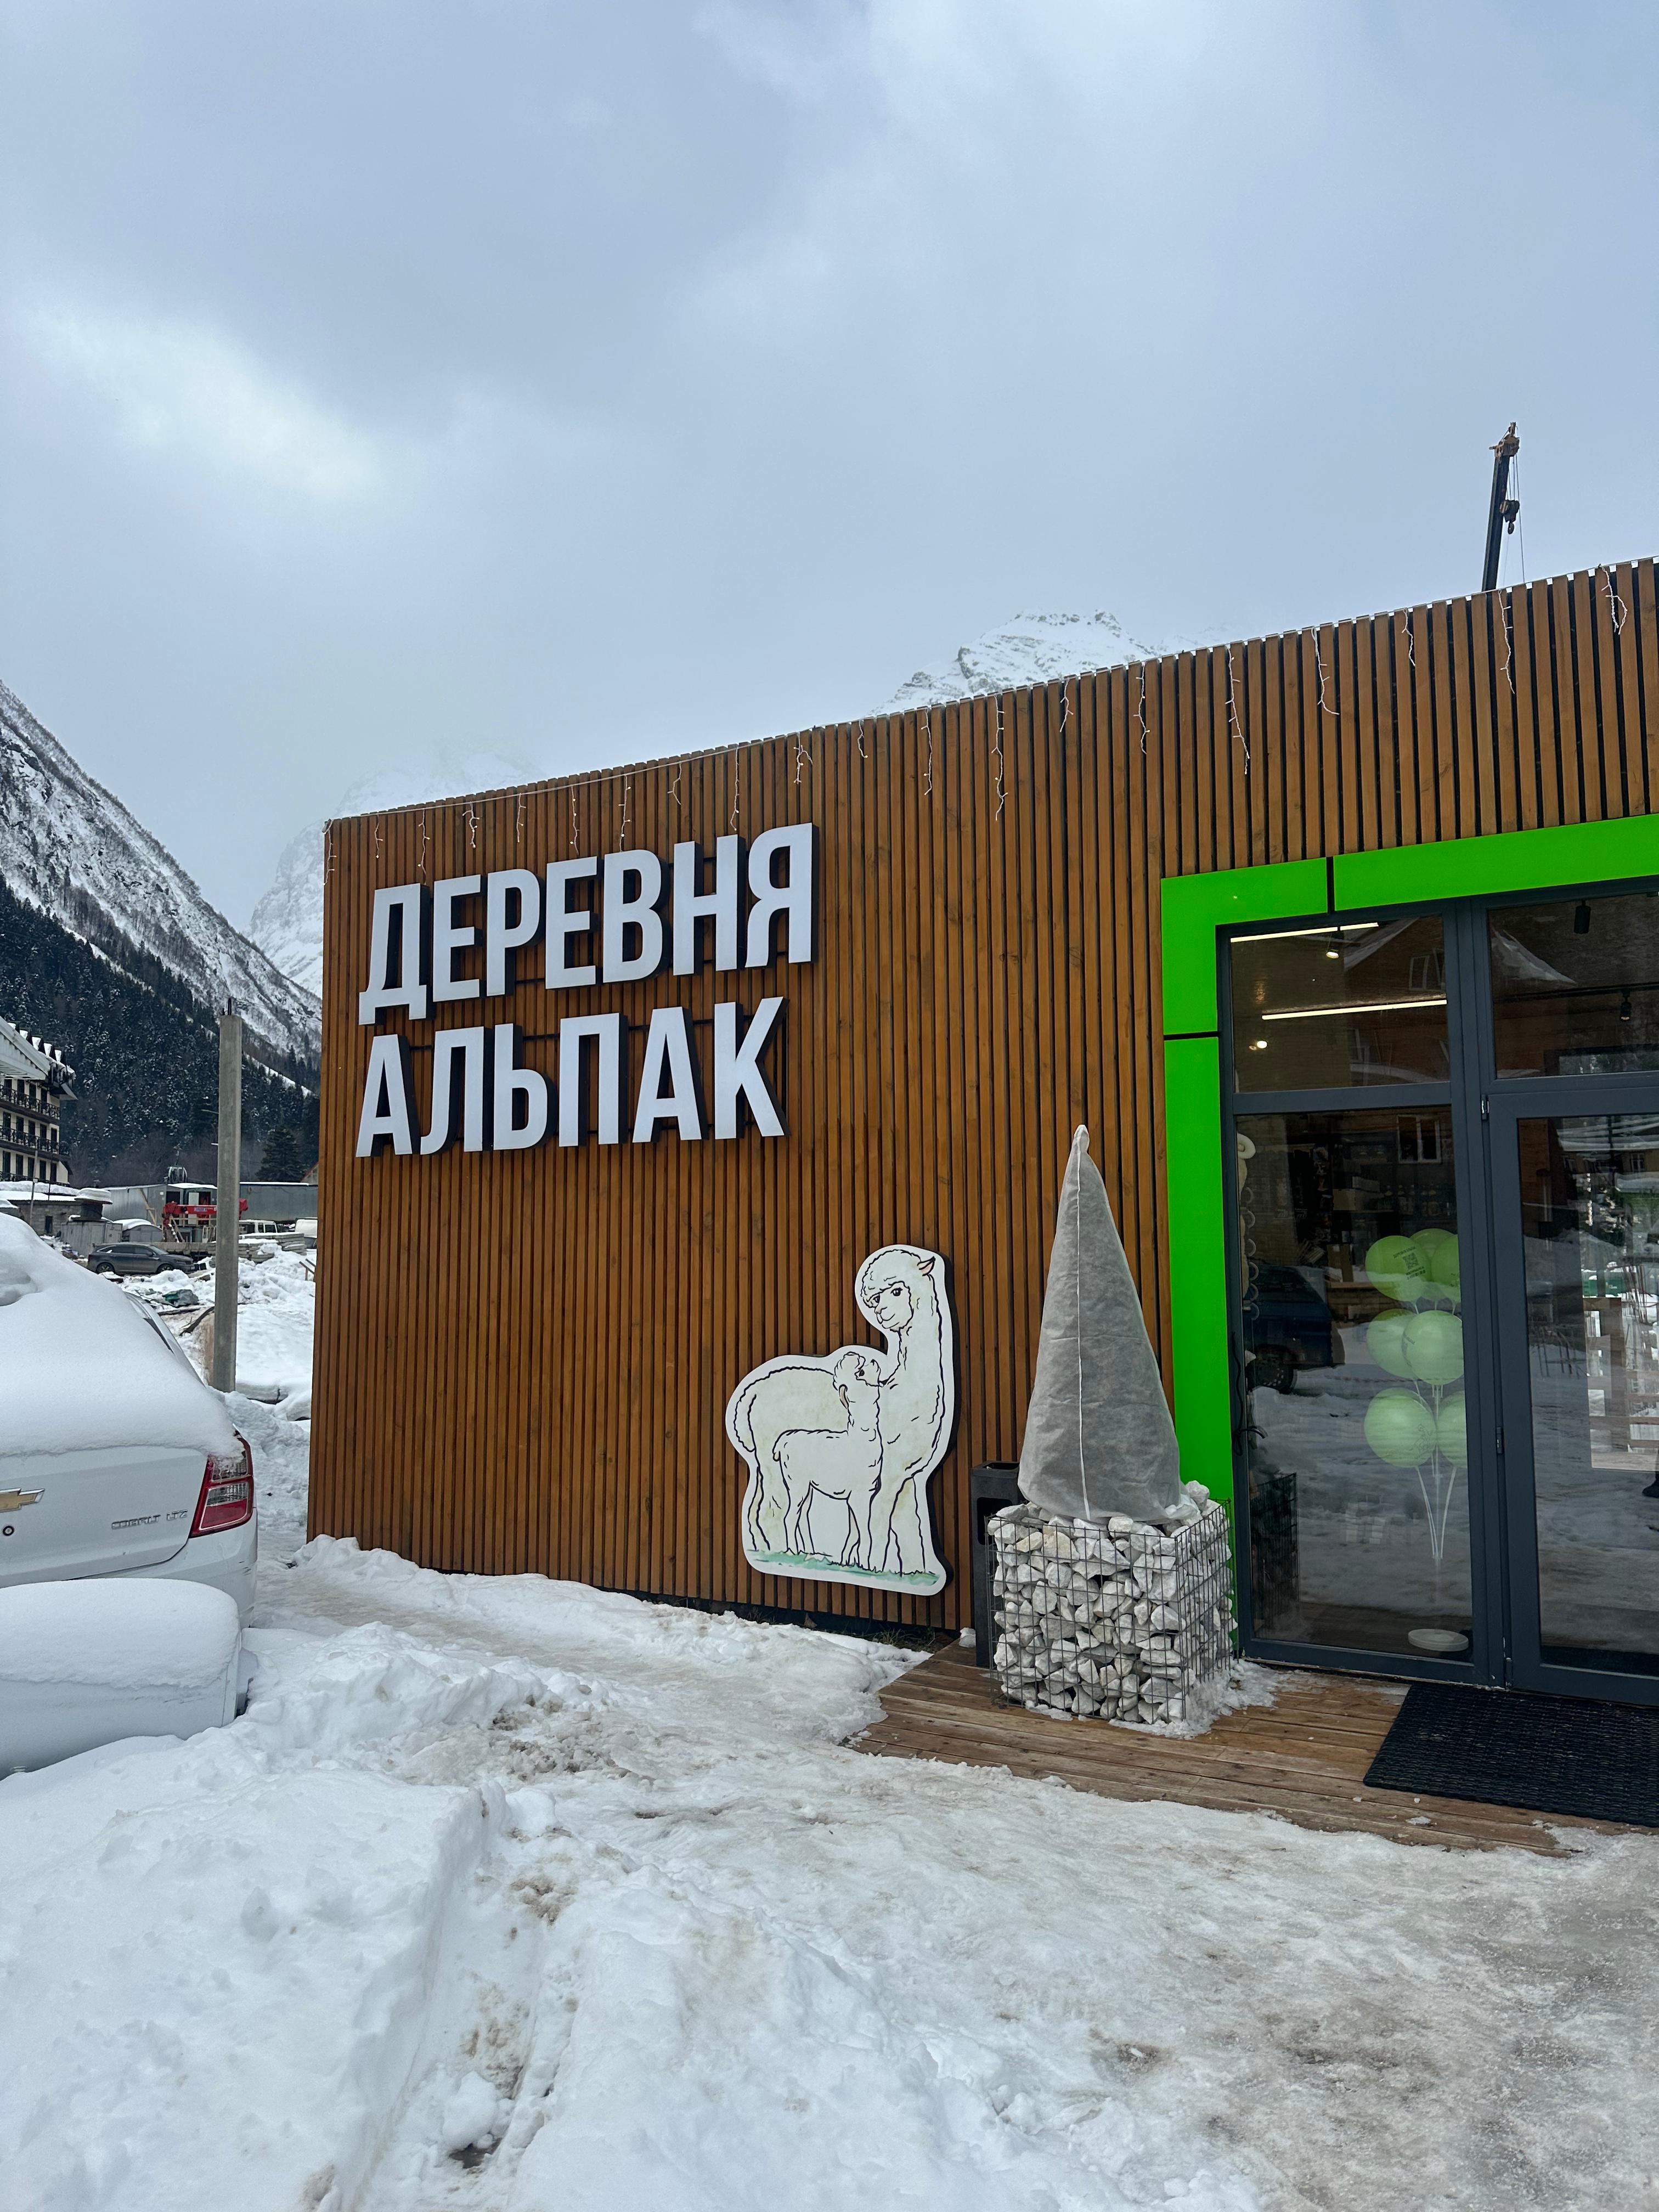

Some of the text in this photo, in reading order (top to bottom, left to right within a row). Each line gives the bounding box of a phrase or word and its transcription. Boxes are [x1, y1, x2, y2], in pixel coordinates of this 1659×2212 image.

[359, 822, 813, 1025] ДЕРЕВНЯ
[356, 996, 784, 1157] АЛЬПАК
[111, 1509, 188, 1530] COBALT LTZ
